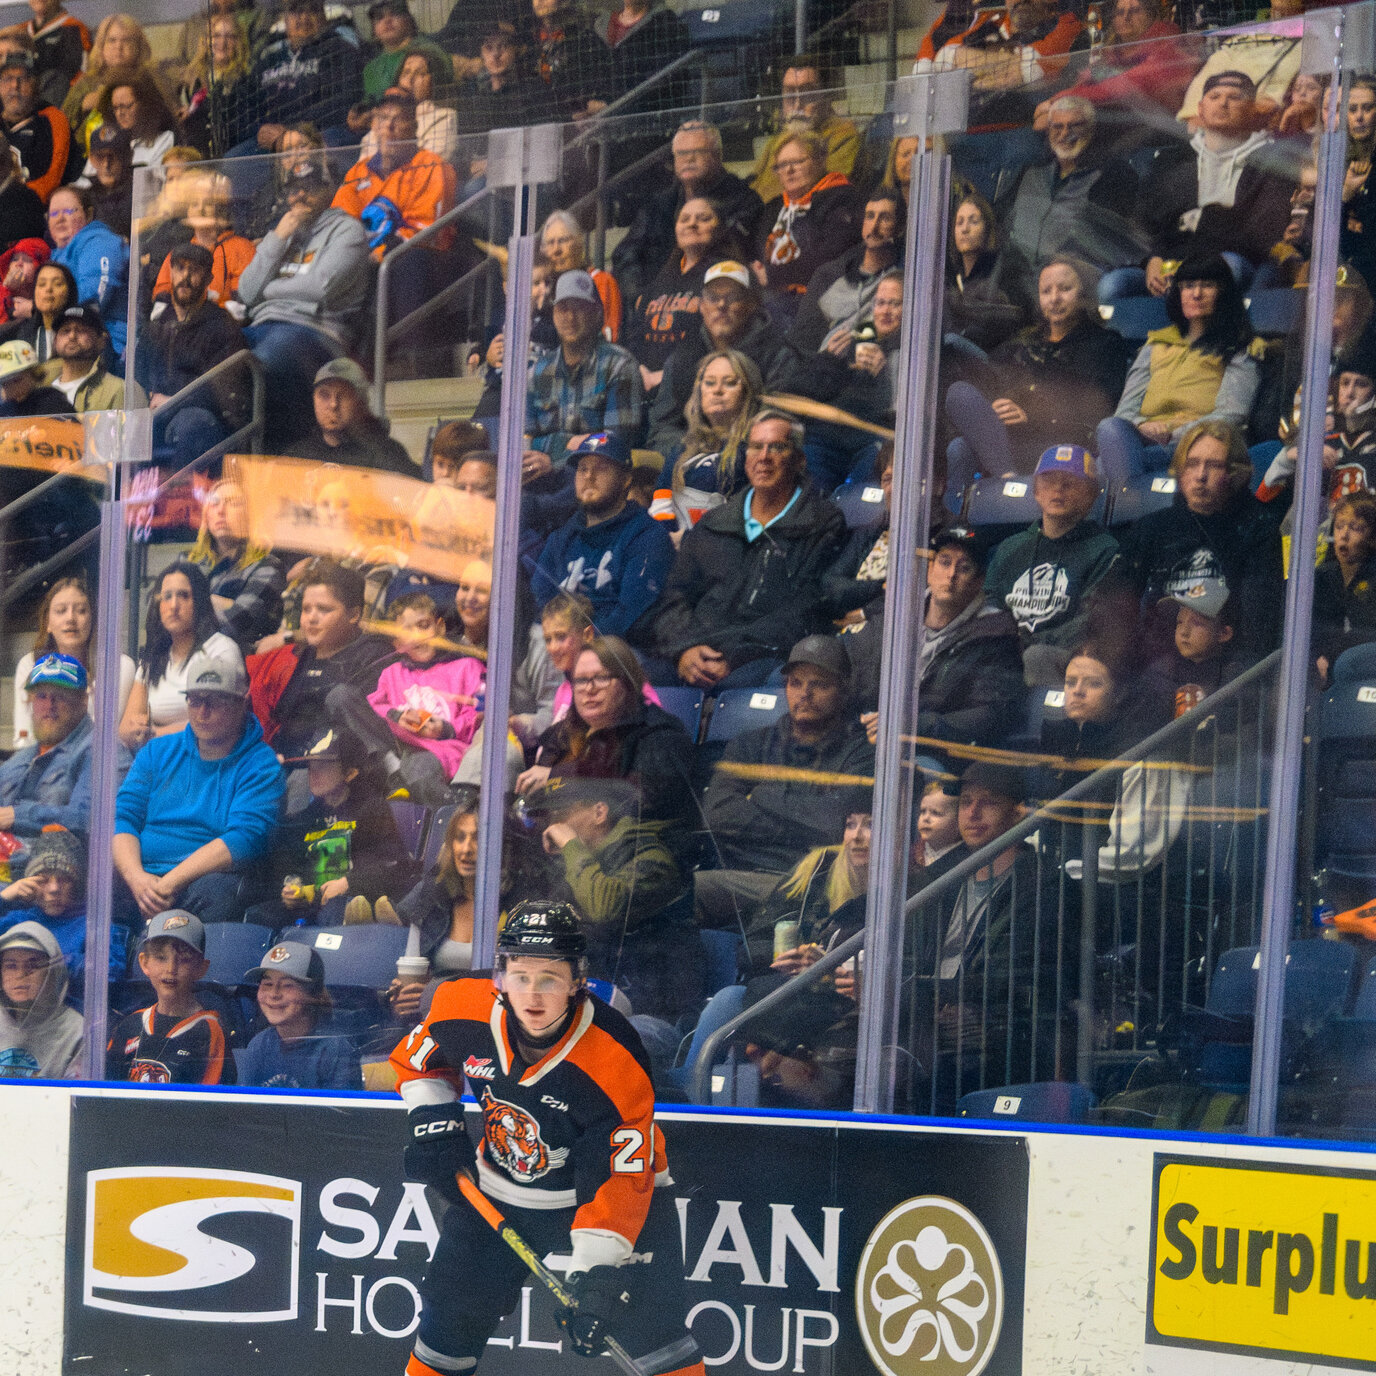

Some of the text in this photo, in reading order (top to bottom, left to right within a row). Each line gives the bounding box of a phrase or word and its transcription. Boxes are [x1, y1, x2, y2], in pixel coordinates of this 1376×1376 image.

[521, 935, 554, 945] CCM
[462, 1061, 496, 1080] WHL
[414, 1120, 465, 1138] CCM
